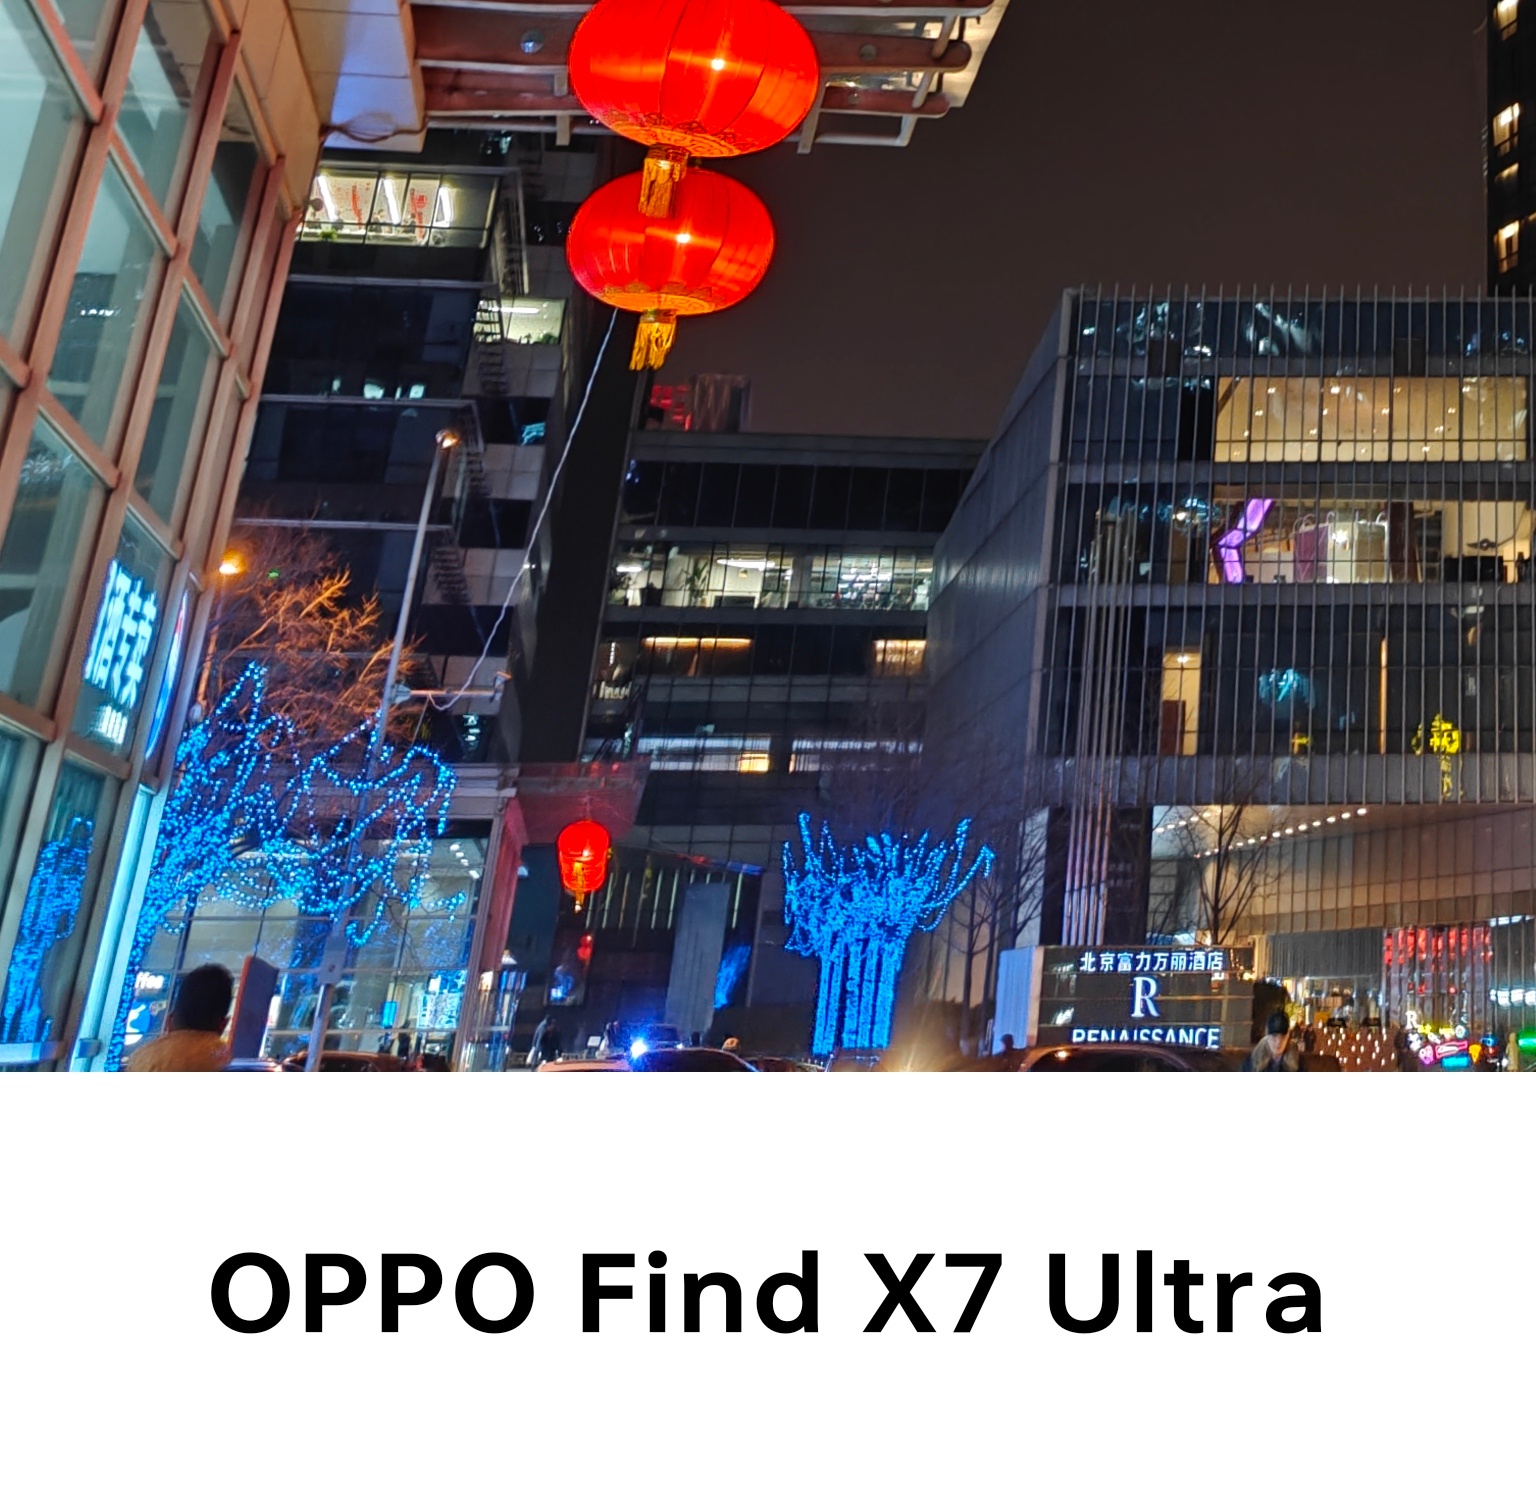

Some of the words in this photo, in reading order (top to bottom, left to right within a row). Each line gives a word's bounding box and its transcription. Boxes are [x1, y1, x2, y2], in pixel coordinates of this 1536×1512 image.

[1079, 951, 1224, 972] 北京富力万丽酒店
[1131, 976, 1160, 1018] R
[1072, 1027, 1221, 1049] RENAISSANCE
